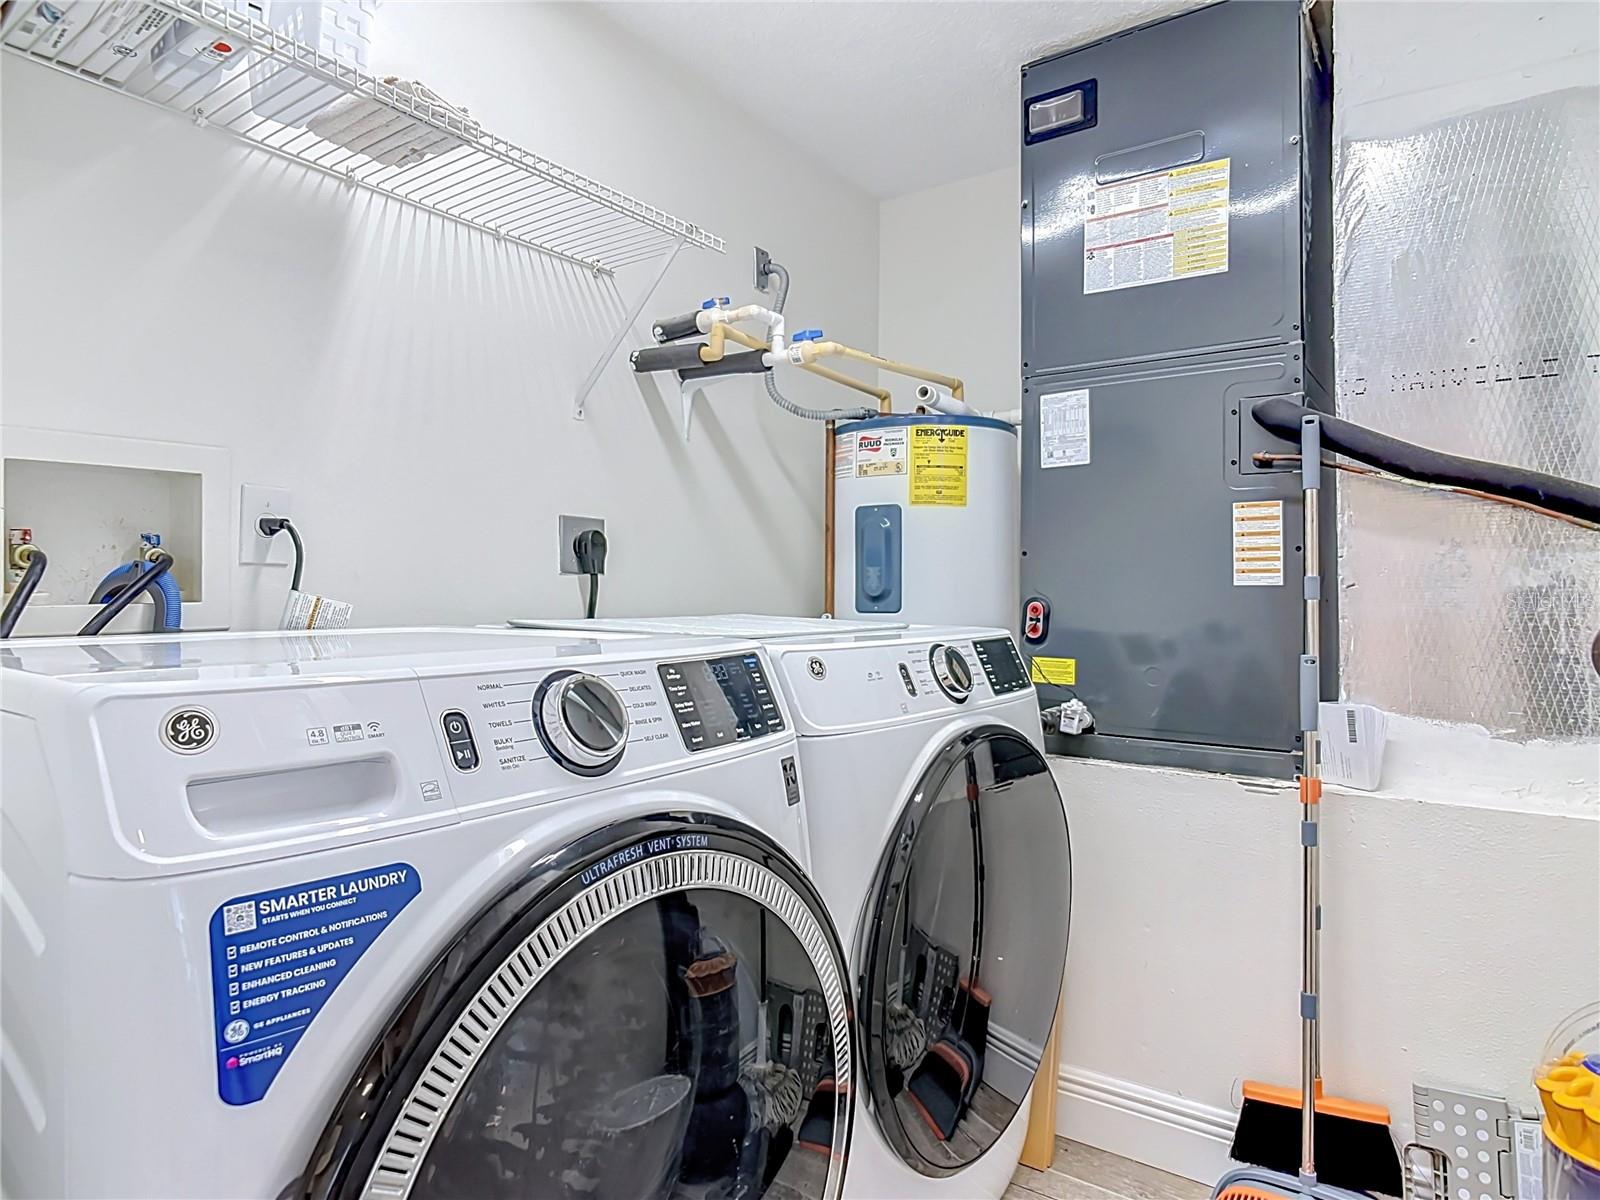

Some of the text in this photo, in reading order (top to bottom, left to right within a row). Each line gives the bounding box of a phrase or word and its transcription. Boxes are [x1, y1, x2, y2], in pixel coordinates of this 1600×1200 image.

[858, 440, 882, 449] RUUD
[477, 683, 503, 691] NORMAL
[482, 701, 506, 709] WHITES
[488, 719, 513, 729] TOWELS
[310, 729, 325, 738] 4.8
[493, 737, 513, 746] BULKY
[499, 755, 526, 765] SANITIZE
[581, 836, 708, 884] ULTRAFRESH VENT SYSTEM
[260, 870, 408, 914] SMARTER LAUNDRY
[262, 897, 357, 925] STARTS WHEN YOU CONNECT
[240, 911, 388, 955] REMOTE CONTROL & NOTIFICATIONS
[241, 938, 354, 973] NEW FEATURES & UPDATES
[242, 959, 337, 991] ENHANCED CLEANING
[243, 980, 326, 1009] ENERGY TRACKING
[265, 1008, 311, 1026] APPLIANCES
